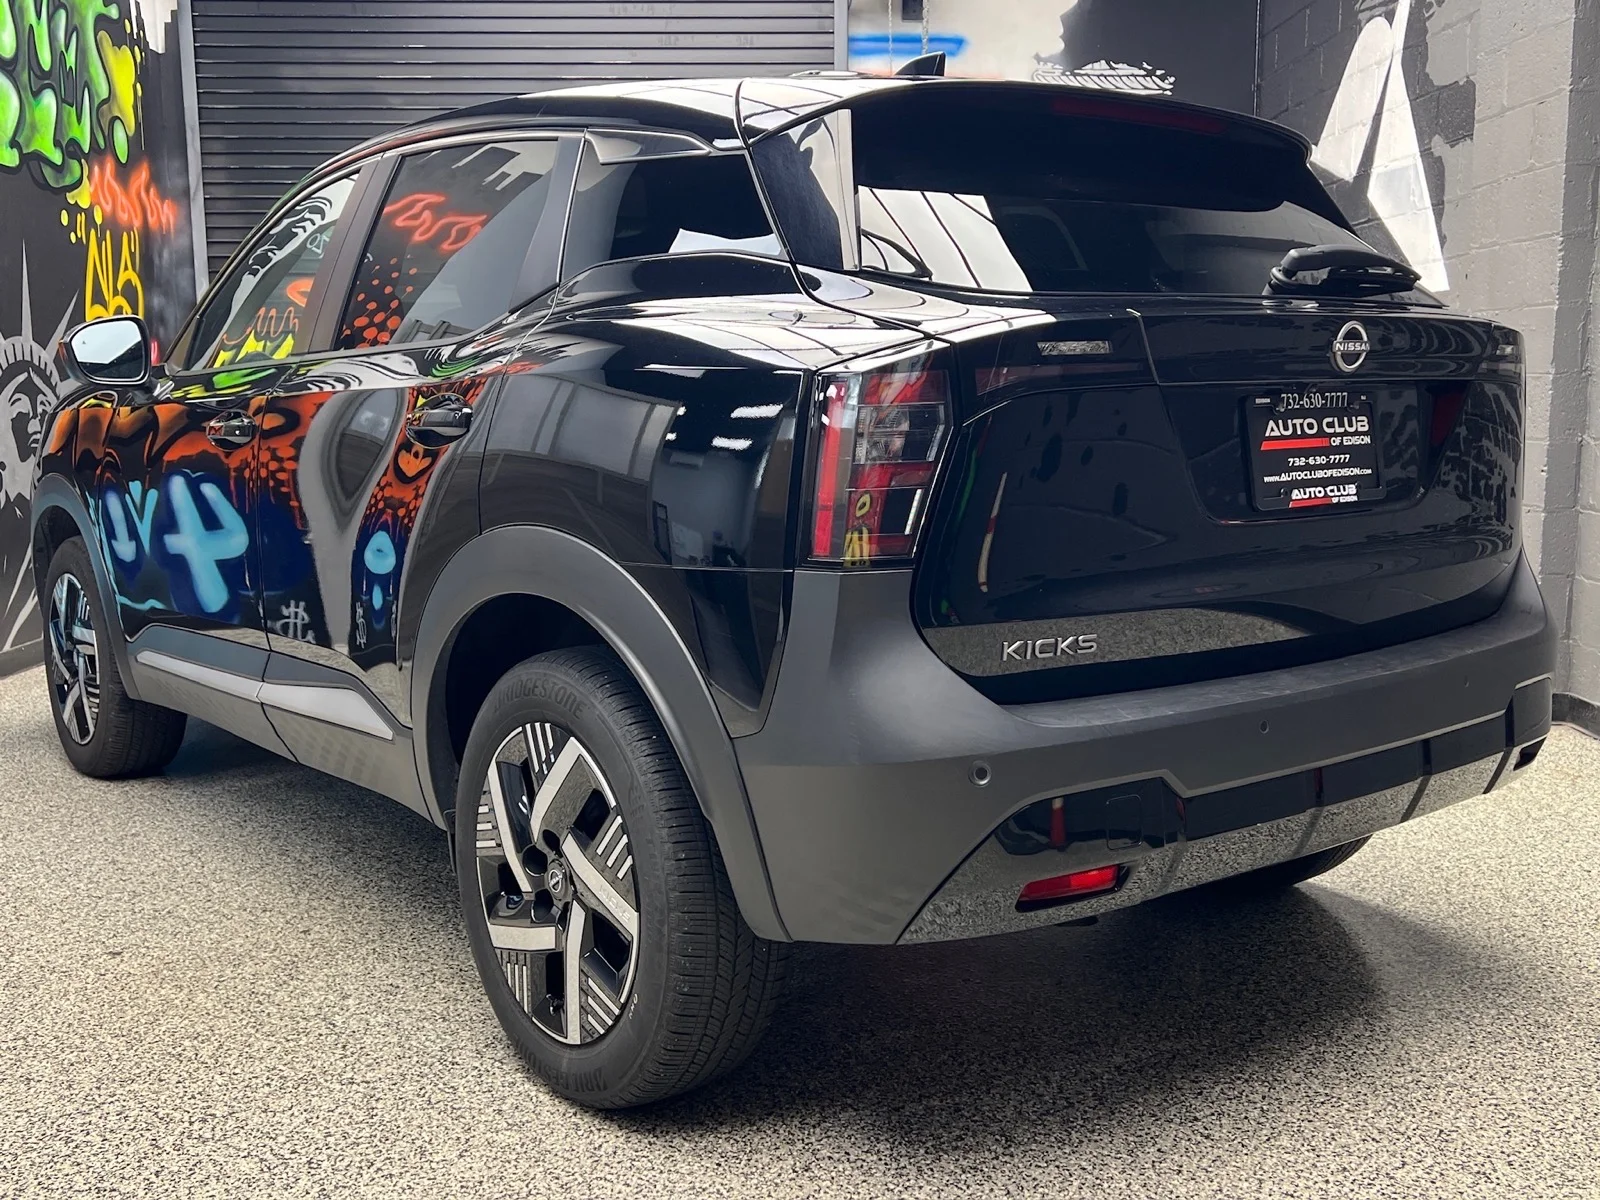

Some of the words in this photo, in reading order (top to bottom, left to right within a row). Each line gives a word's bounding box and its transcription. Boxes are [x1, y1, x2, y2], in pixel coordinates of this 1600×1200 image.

[1335, 342, 1369, 351] NISSAN
[1280, 392, 1348, 410] 732-630-7777
[1265, 417, 1319, 437] AUTO
[1322, 415, 1370, 434] CLUB
[1330, 436, 1342, 446] OF
[1343, 435, 1371, 445] EDISON
[1288, 454, 1350, 467] 732-630-7777
[1291, 486, 1325, 500] AUTO
[1325, 484, 1357, 497] CLUB
[1003, 633, 1098, 661] KICKS
